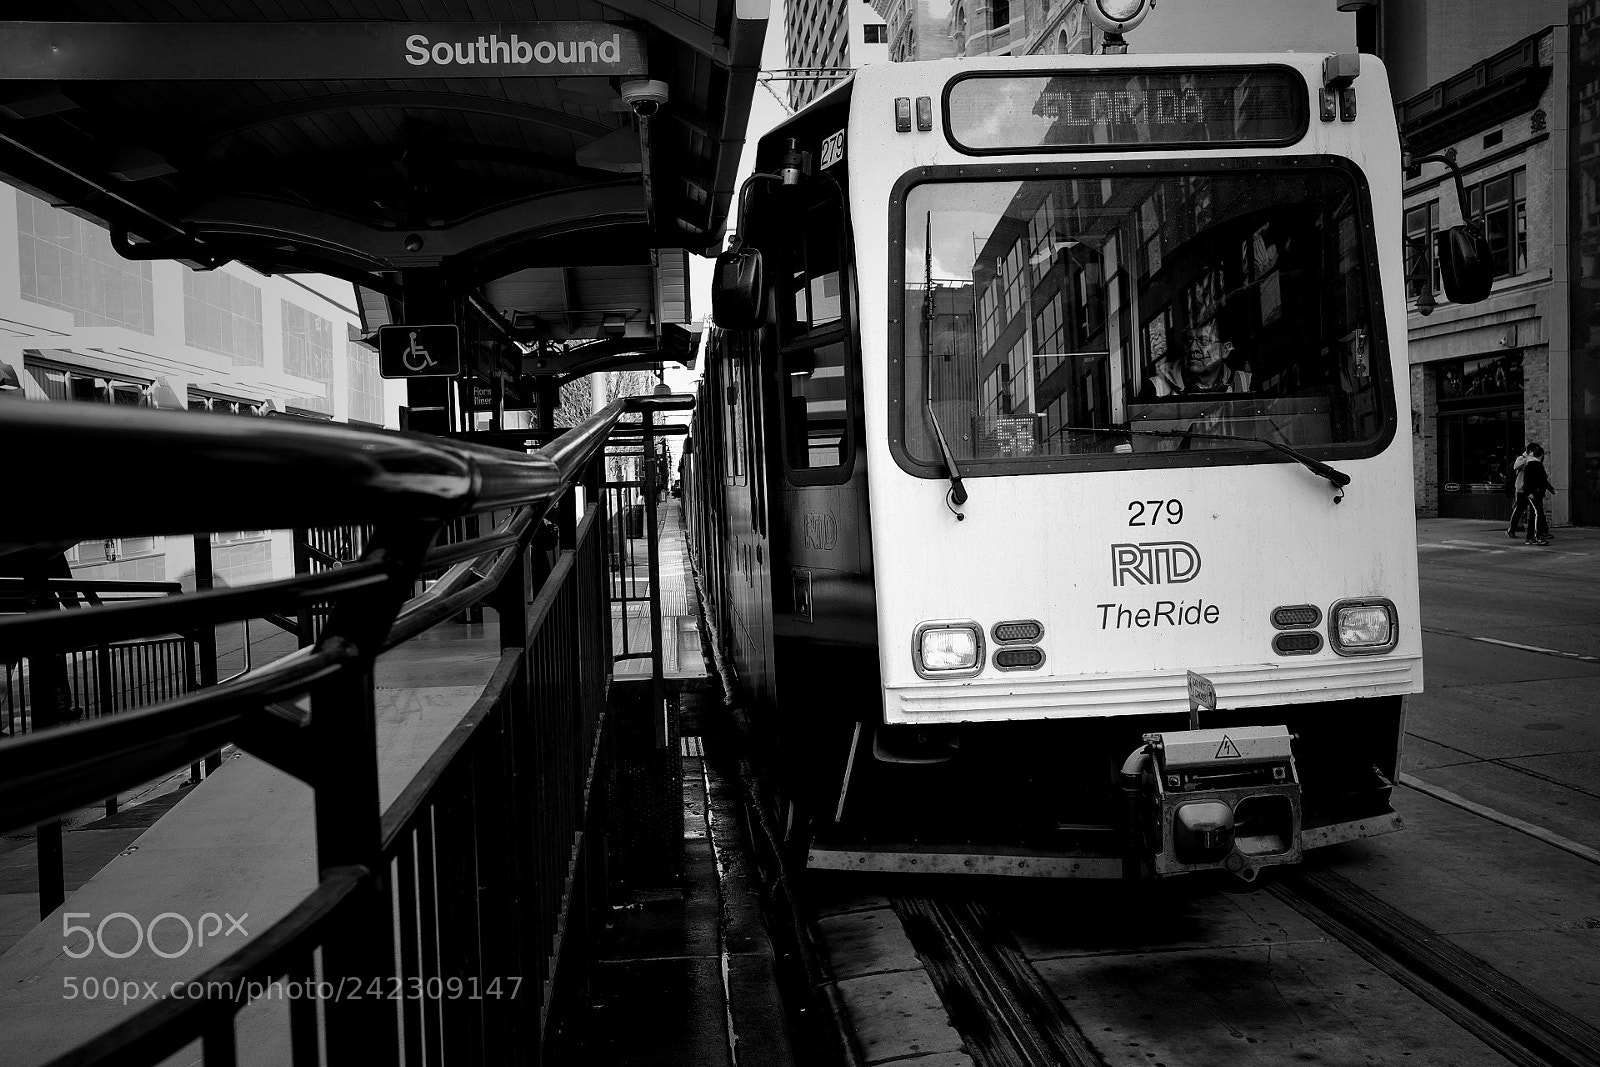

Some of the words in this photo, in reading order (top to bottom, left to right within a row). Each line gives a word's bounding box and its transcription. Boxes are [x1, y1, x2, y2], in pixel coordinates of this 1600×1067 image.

[405, 33, 621, 66] Southbound
[1042, 89, 1203, 127] FLORIDA
[822, 132, 844, 167] 279
[1128, 498, 1184, 527] 279
[1111, 540, 1202, 587] RTD
[1096, 598, 1220, 630] TheRide
